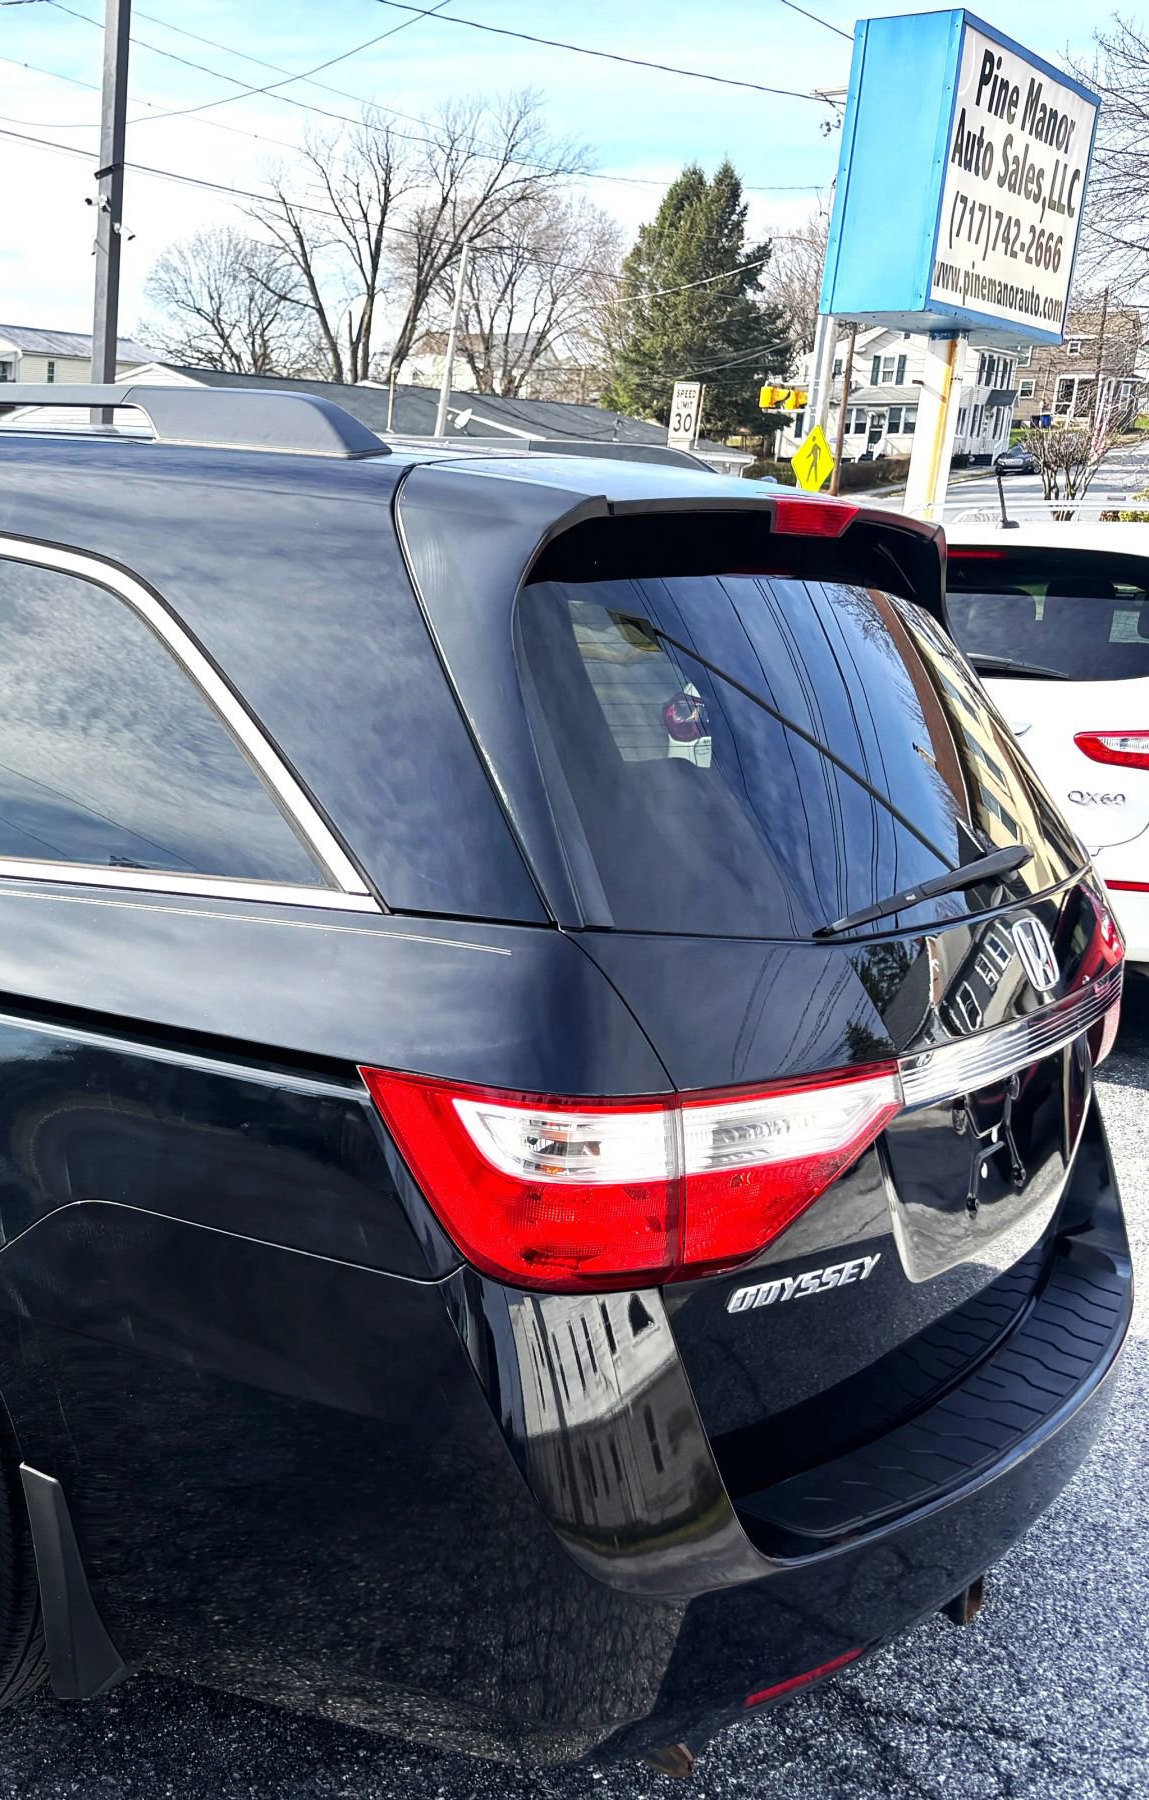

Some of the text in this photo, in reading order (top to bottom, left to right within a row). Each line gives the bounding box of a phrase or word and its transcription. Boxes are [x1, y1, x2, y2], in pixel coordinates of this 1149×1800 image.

[975, 48, 1076, 154] Pine Manor
[951, 107, 1081, 223] Auto Sales,LLC
[948, 190, 1063, 274] (717)742-2666
[933, 260, 1063, 323] www.pinemanorauto.com
[673, 412, 693, 432] 30
[676, 389, 697, 399] SPEED
[676, 401, 694, 410] LIMIT
[1067, 790, 1126, 806] QX60
[726, 1252, 882, 1314] ODYSSEY
